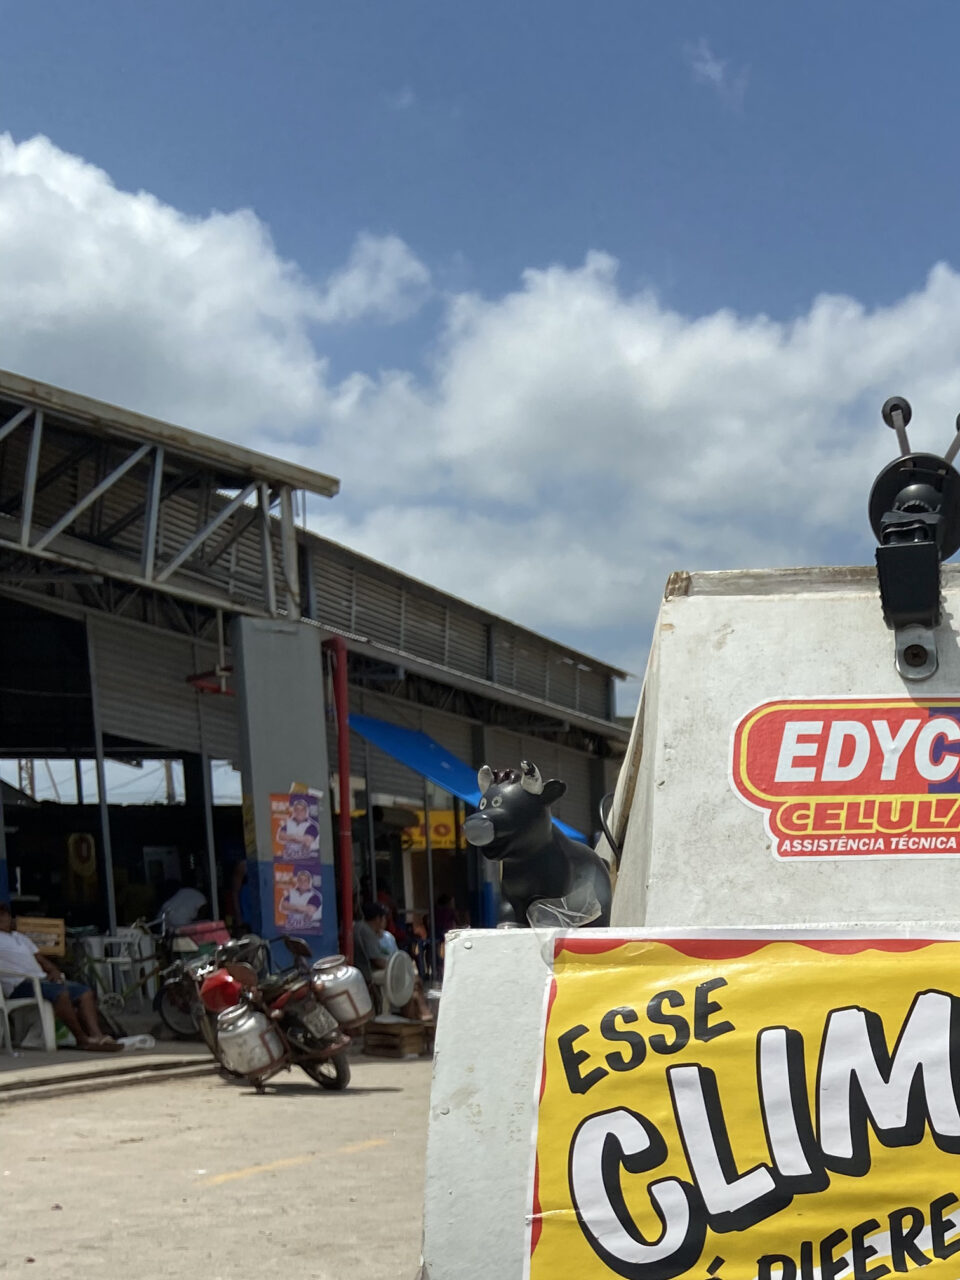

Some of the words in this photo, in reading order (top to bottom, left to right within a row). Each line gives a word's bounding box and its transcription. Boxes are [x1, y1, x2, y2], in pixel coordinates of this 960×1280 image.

[781, 835, 885, 852] ASSISTÊNCIA
[890, 835, 957, 850] TÉCNICA
[557, 976, 736, 1095] ESSE
